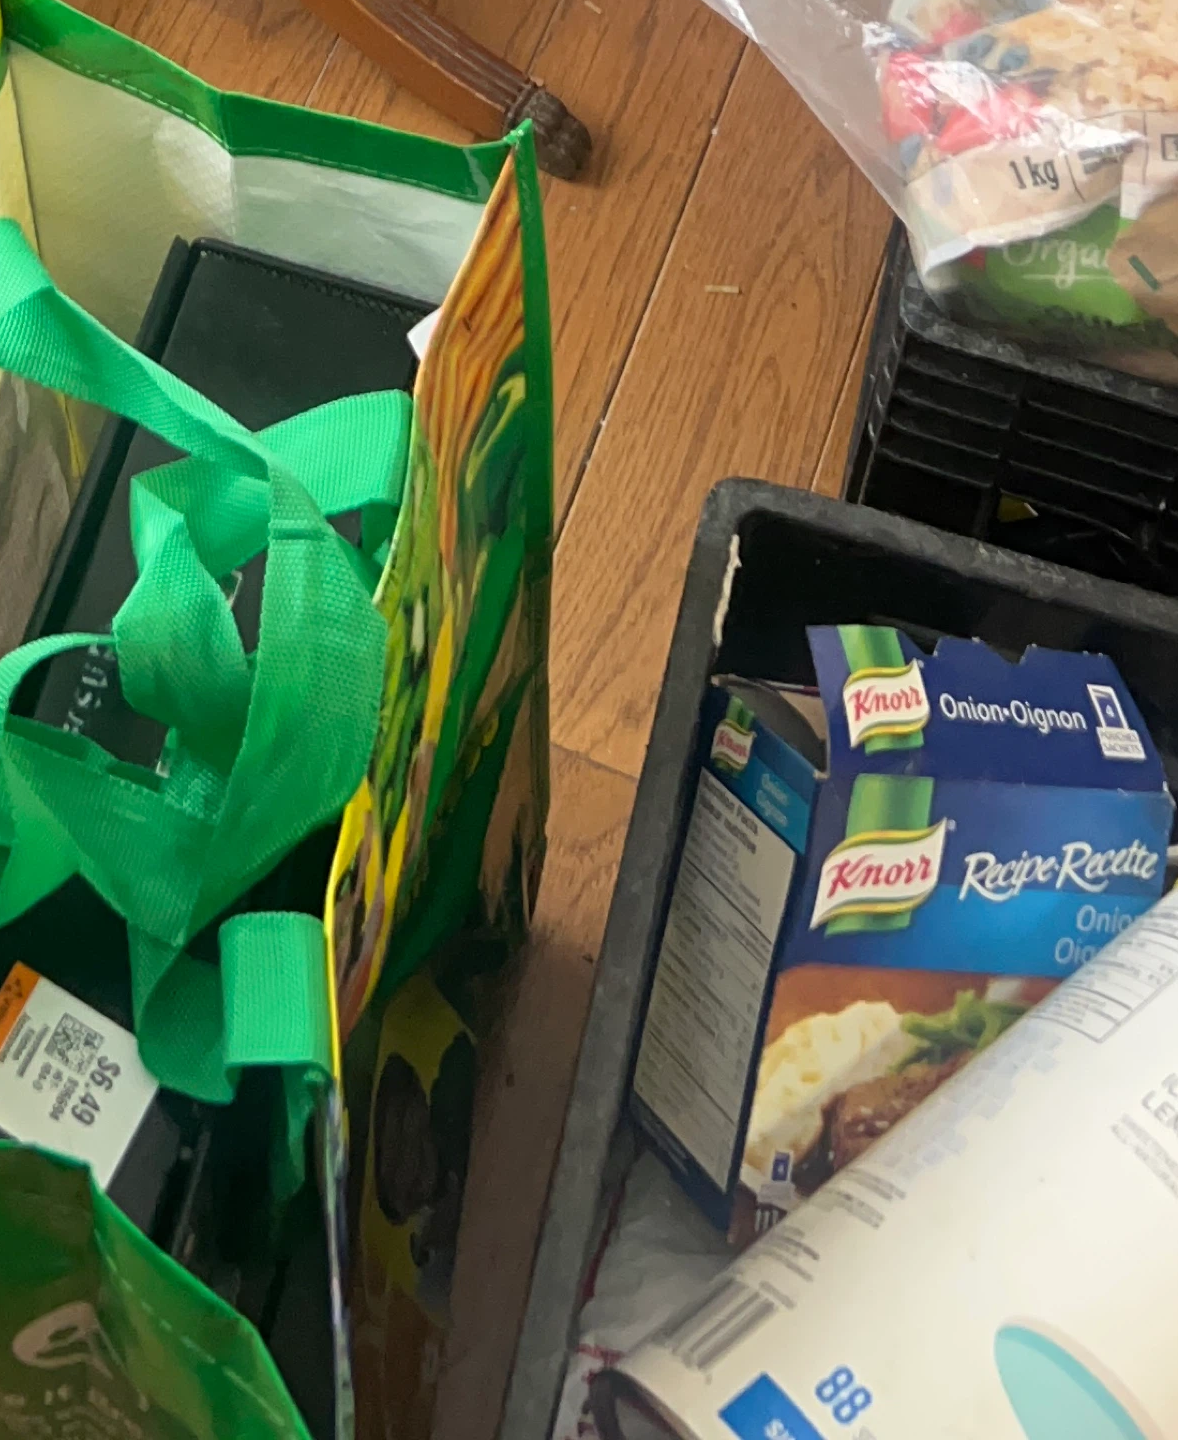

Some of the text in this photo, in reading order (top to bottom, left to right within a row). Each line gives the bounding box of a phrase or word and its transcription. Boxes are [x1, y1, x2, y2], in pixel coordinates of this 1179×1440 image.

[1025, 156, 1059, 190] kg
[853, 685, 922, 722] Knorr
[827, 853, 933, 900] Knorr
[71, 1055, 121, 1126] $6.49
[815, 1365, 872, 1425] 88
